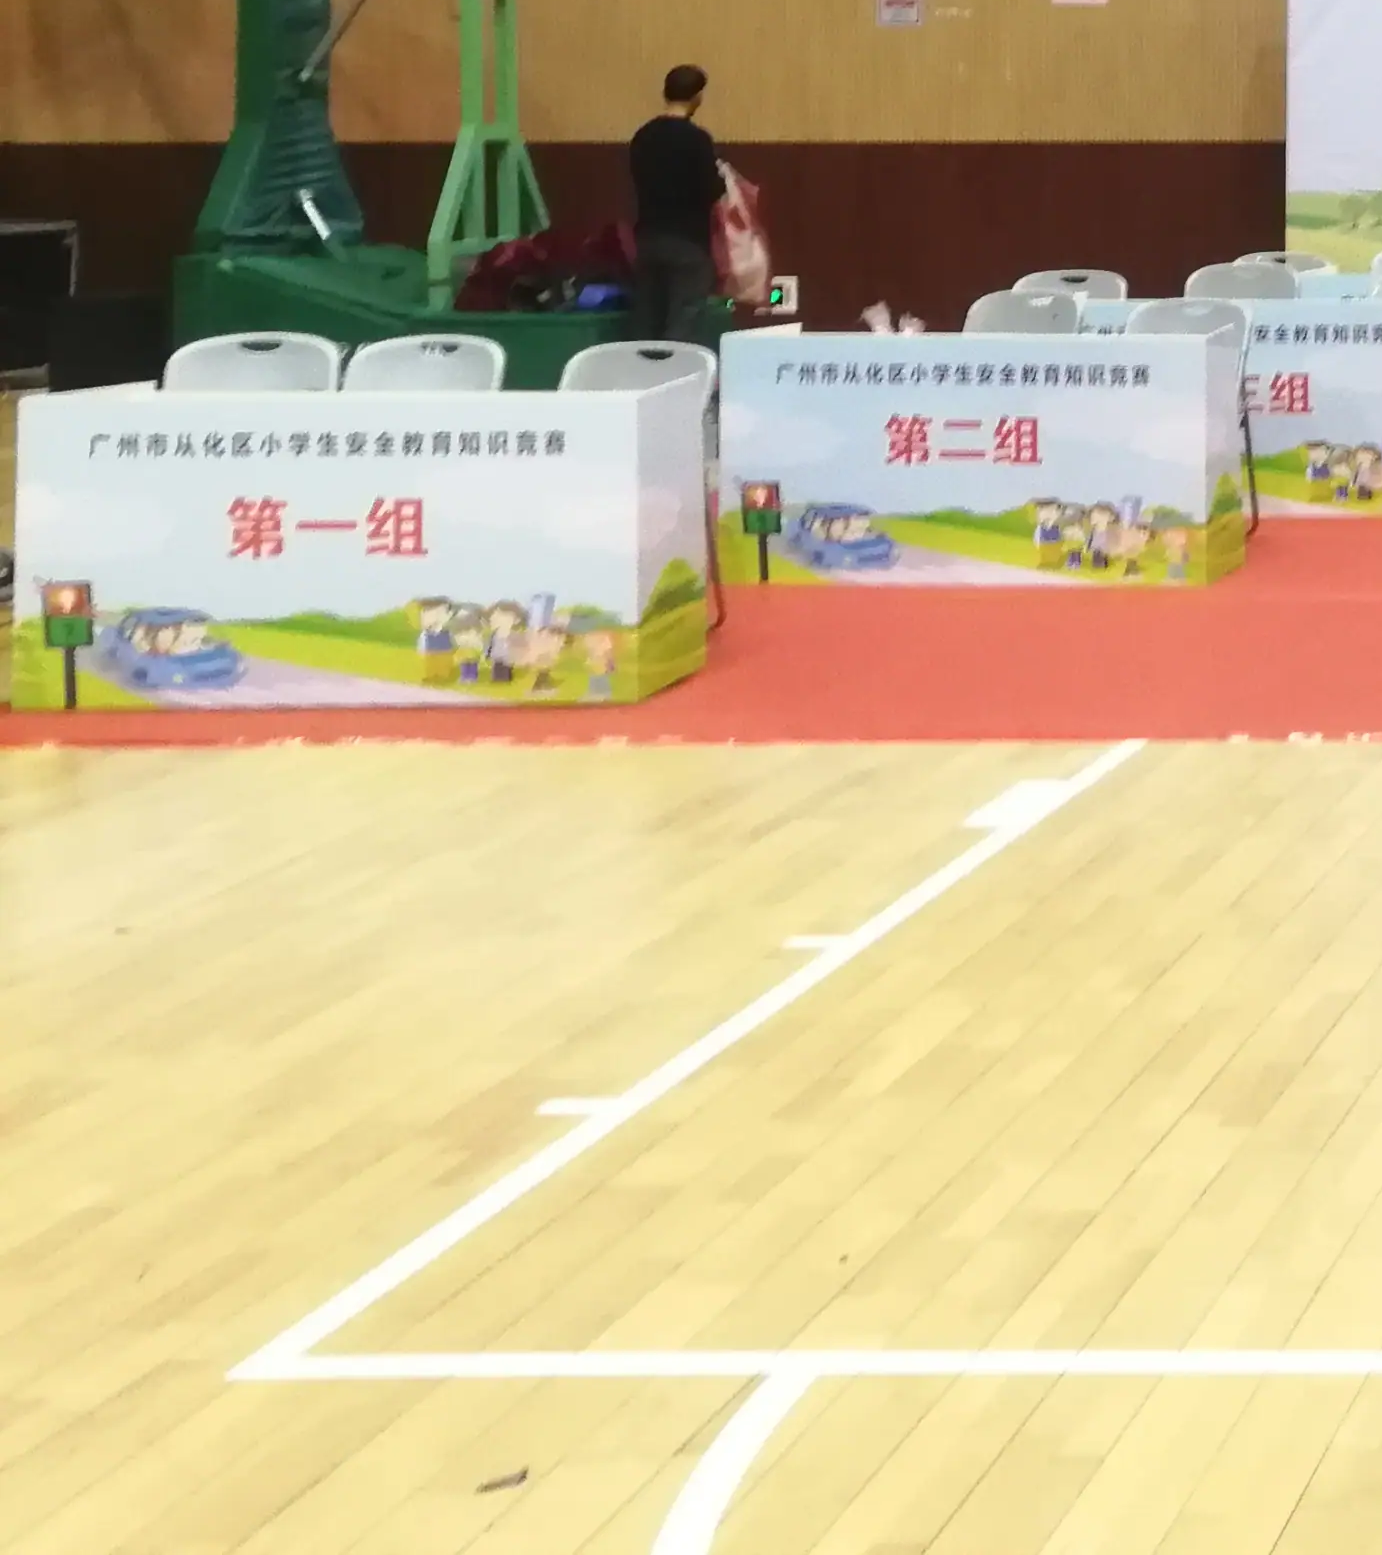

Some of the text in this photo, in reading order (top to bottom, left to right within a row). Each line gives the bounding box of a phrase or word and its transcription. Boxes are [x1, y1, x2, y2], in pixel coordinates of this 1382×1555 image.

[776, 362, 1150, 387] 广州市从化区小学生安全教育知识竞赛
[89, 431, 566, 458] 广州市从化区小学生安全教育知识竞赛
[885, 413, 1043, 466] 第二组
[227, 495, 430, 560] 第一组
